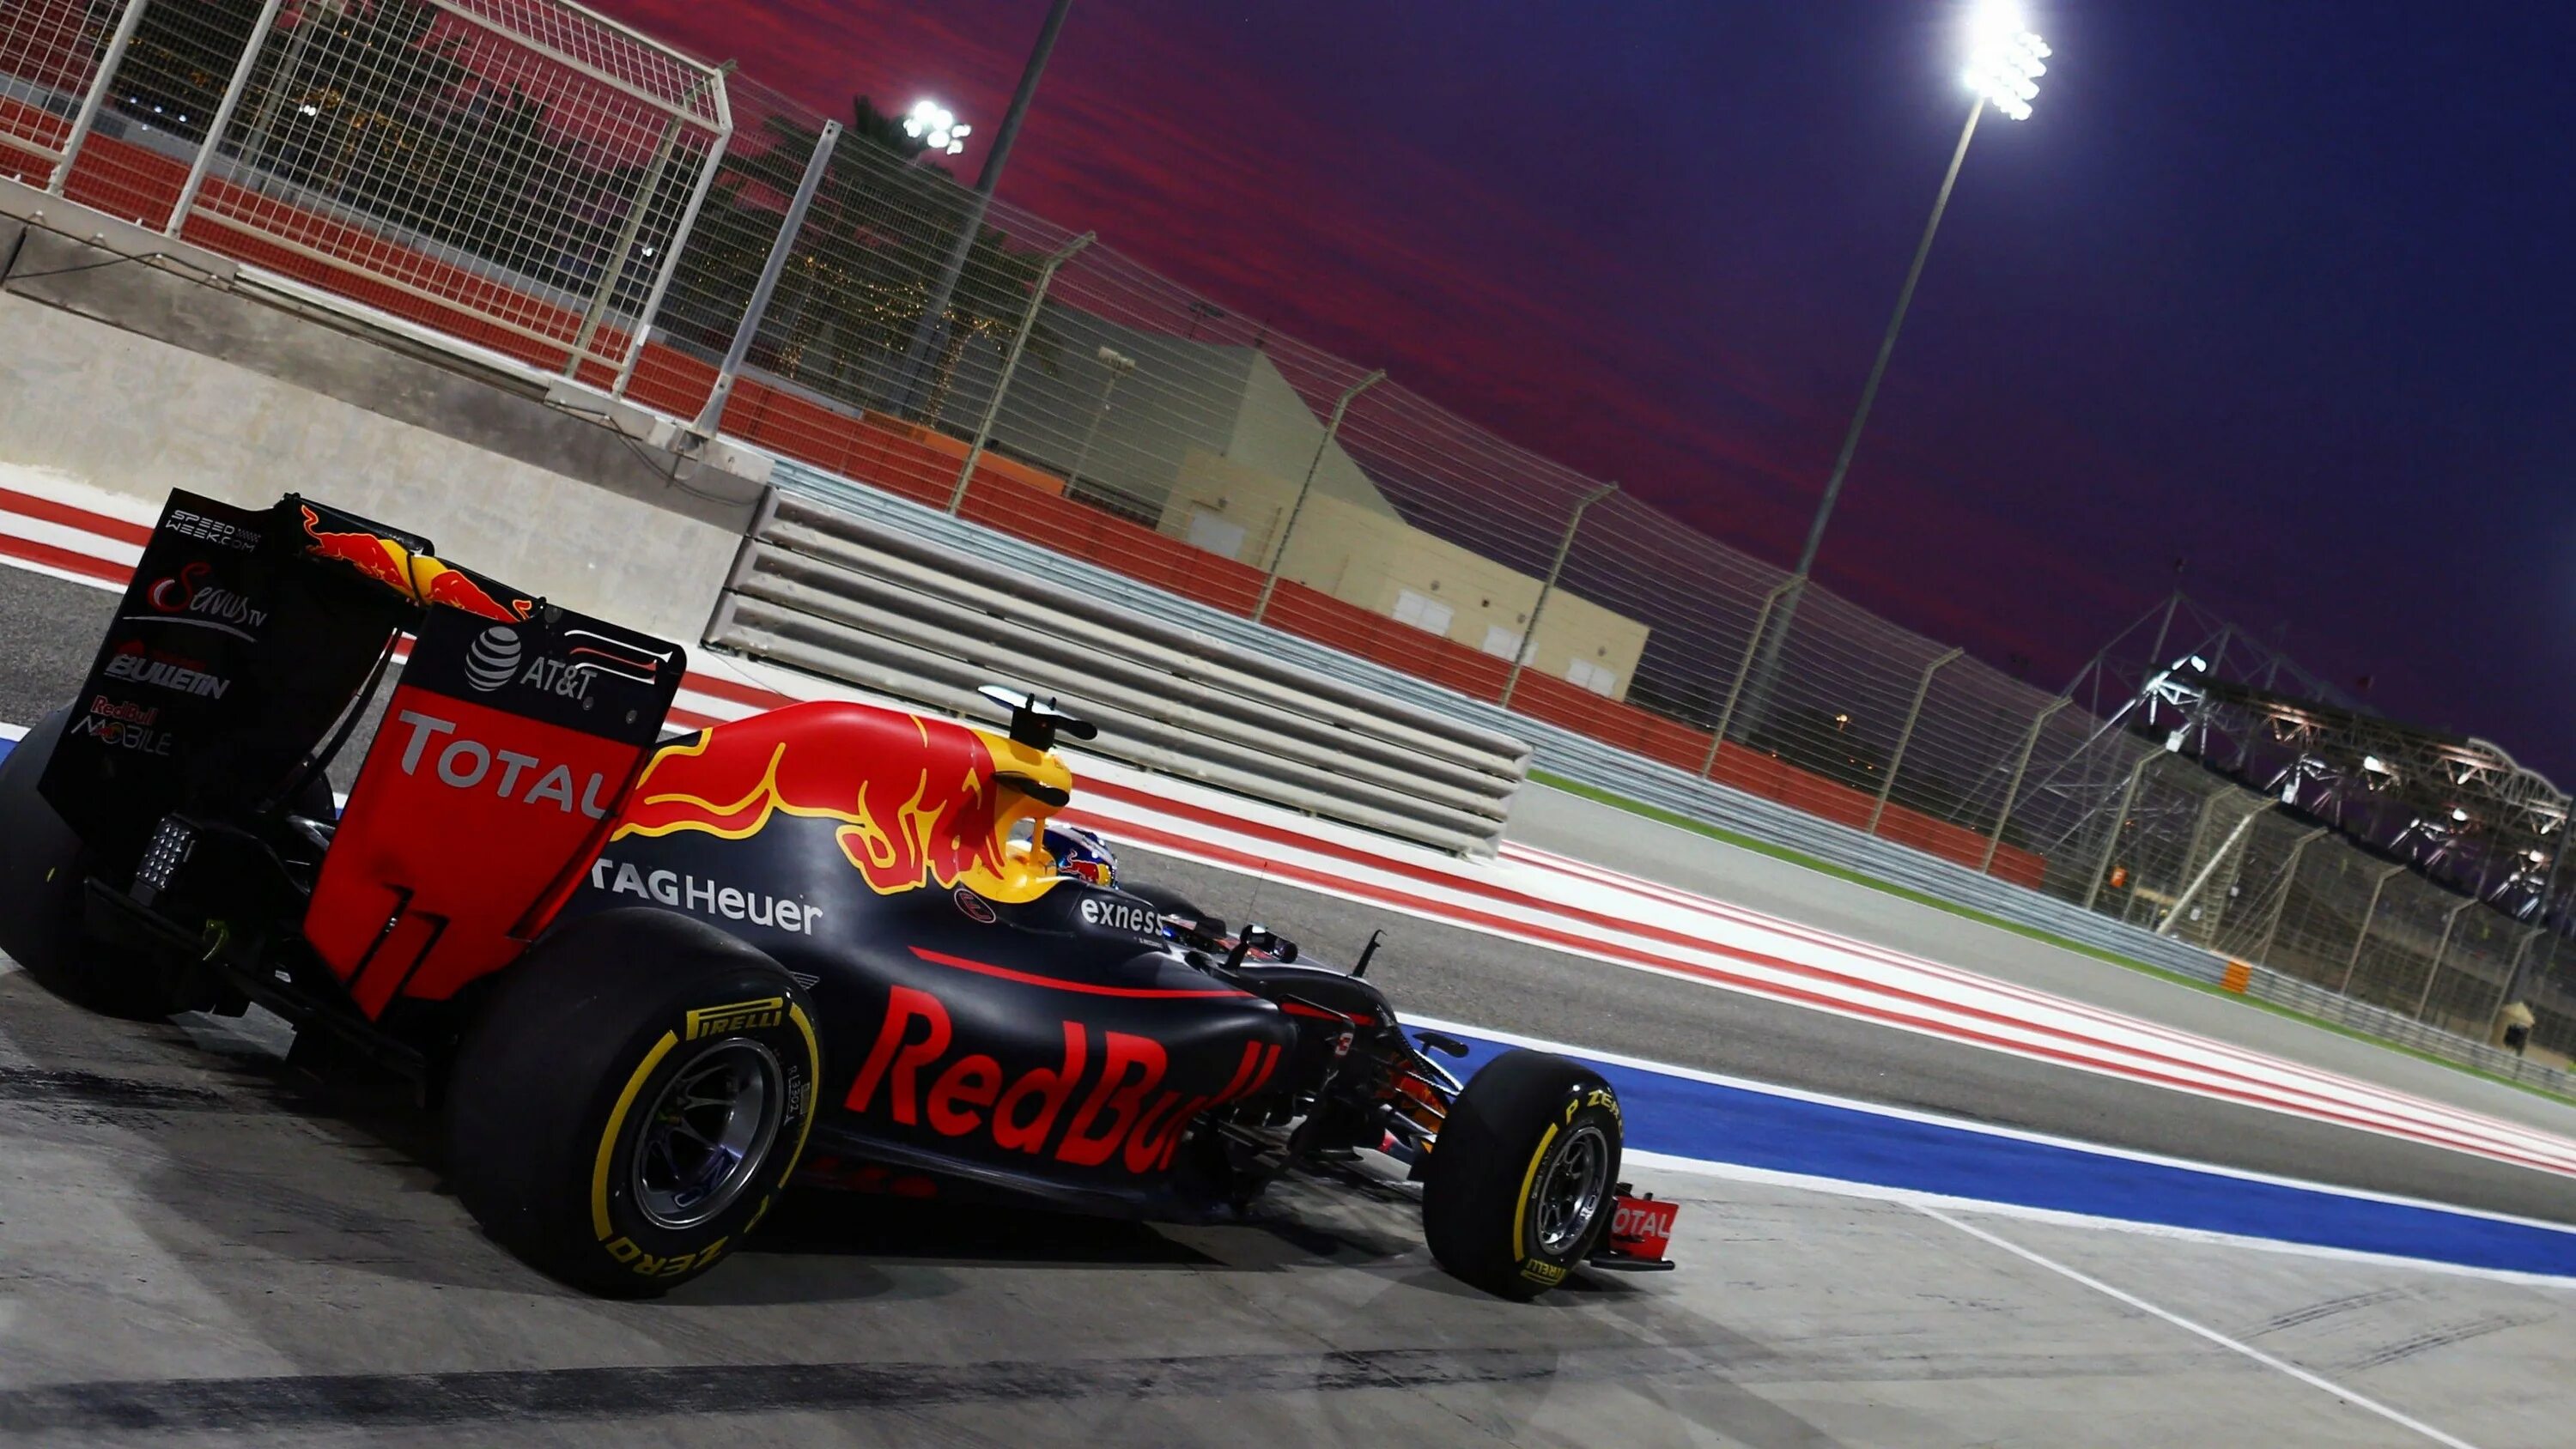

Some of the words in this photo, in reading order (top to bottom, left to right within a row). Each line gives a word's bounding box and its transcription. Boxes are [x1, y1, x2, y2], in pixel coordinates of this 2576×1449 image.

[171, 509, 235, 536] SPEED
[104, 654, 231, 700] BULLETIN
[519, 657, 598, 700] AT&T
[398, 709, 608, 820] TOTAL
[1081, 898, 1163, 937] exness
[685, 997, 784, 1042] PIRELLI
[1611, 1203, 1670, 1240] OTAL
[605, 1236, 729, 1278] ZERO
